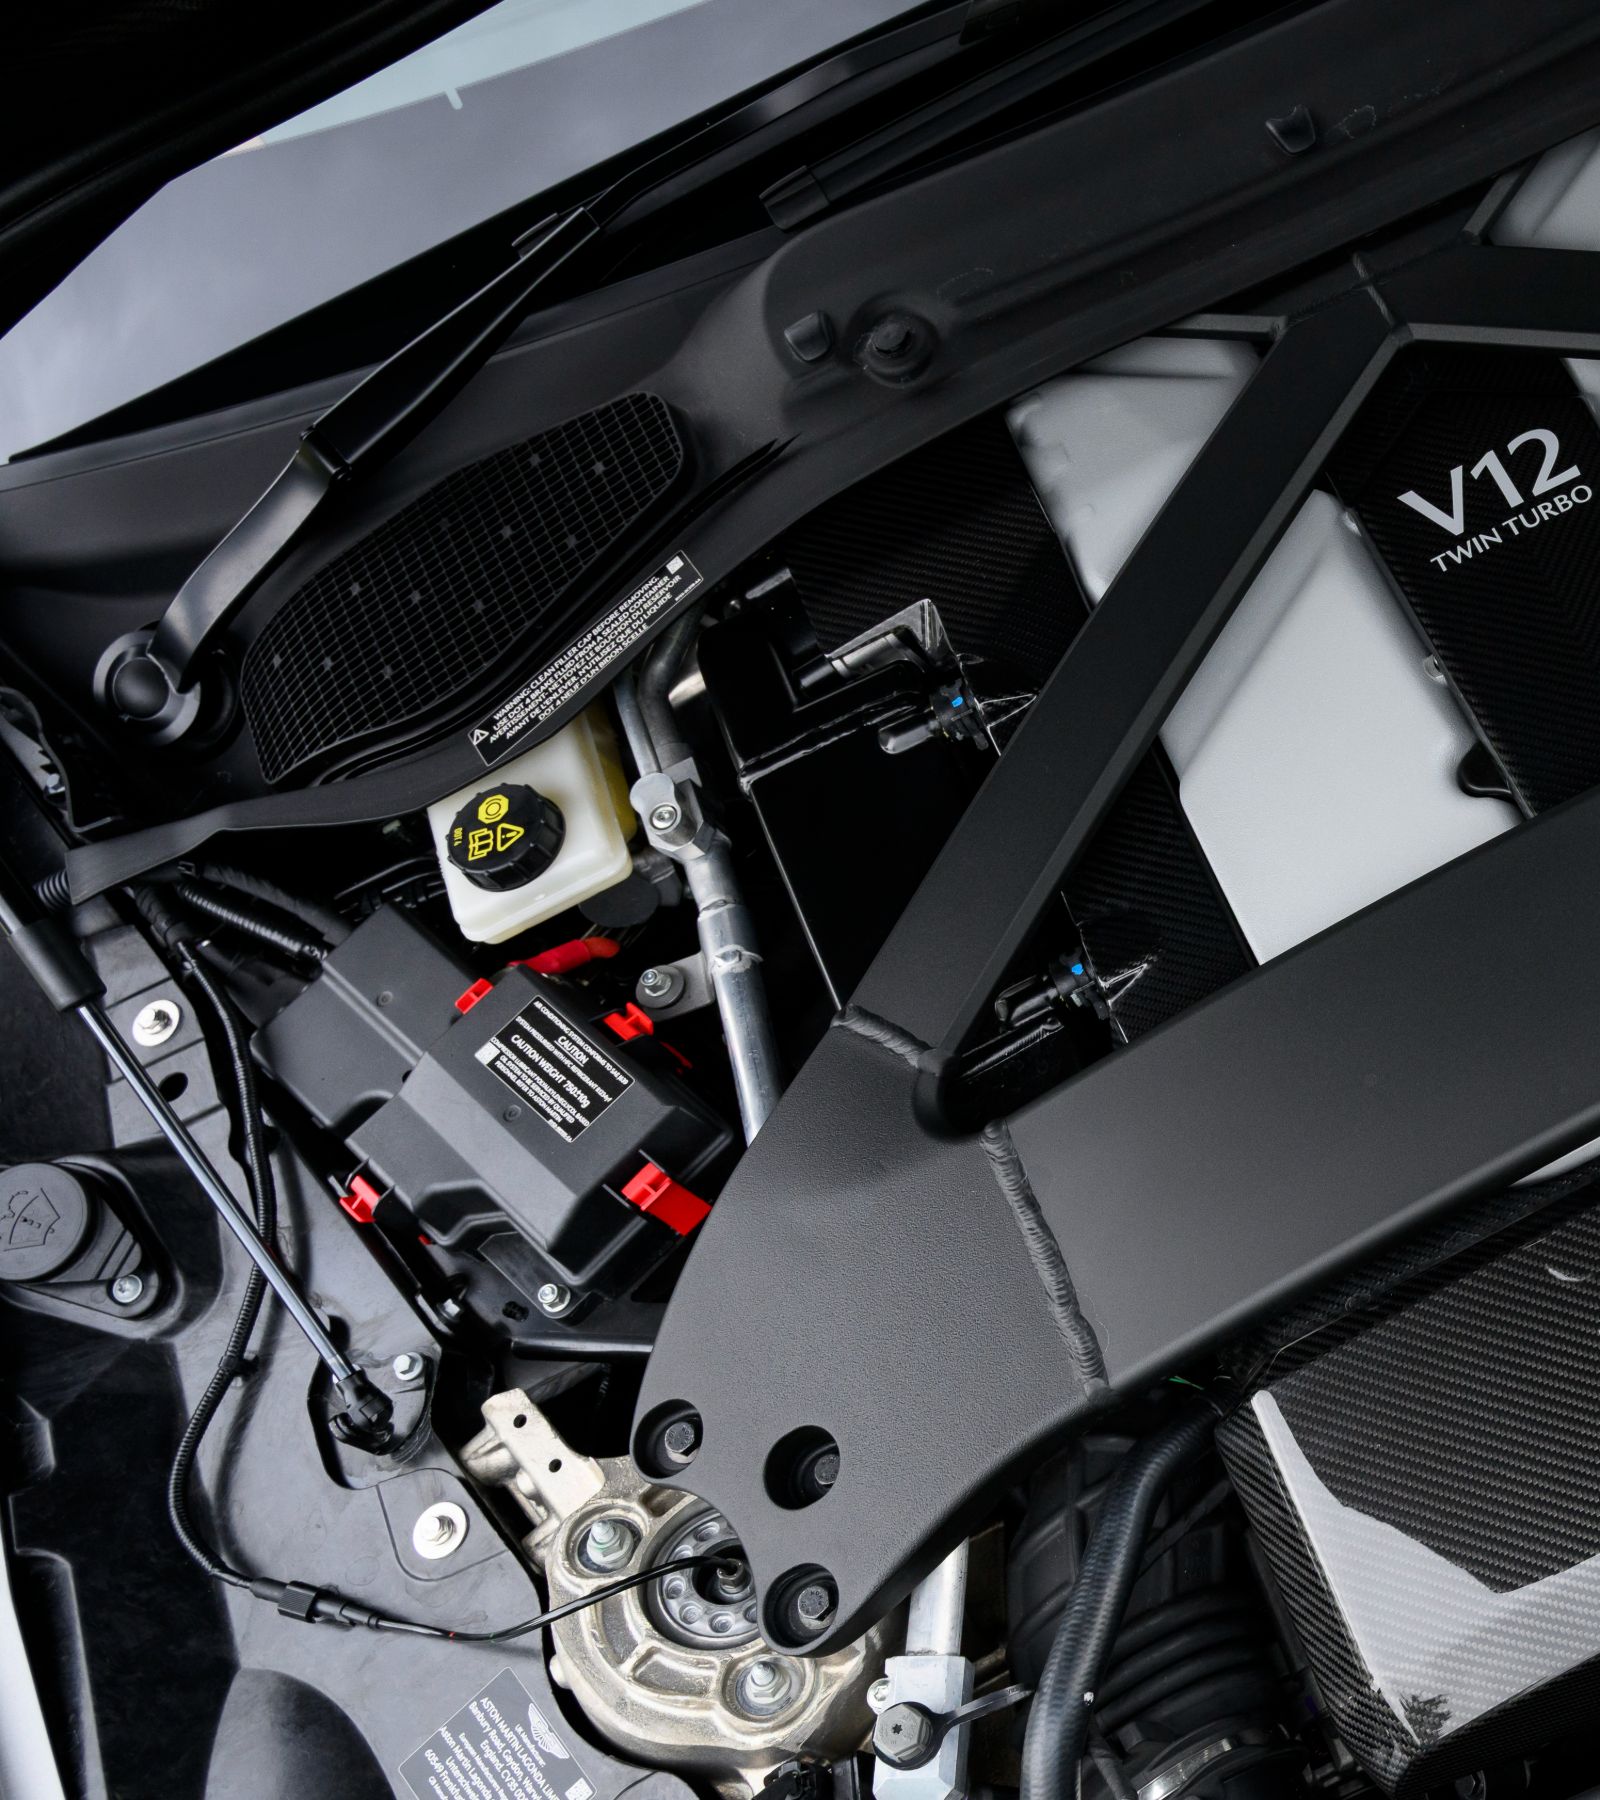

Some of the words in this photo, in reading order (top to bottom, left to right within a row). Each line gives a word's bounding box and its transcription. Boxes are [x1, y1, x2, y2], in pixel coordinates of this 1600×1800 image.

[1397, 429, 1581, 536] V12
[1430, 527, 1503, 572] TWIN
[1502, 485, 1592, 535] TURBO
[493, 716, 509, 733] USE
[508, 702, 524, 719] DOT
[530, 677, 555, 700] BRAKE
[554, 659, 575, 679] FLUID
[574, 640, 597, 661] FROM
[601, 611, 629, 637] SEALED
[629, 576, 670, 613] CONTAINER
[493, 688, 532, 720] WARNING:
[530, 666, 556, 689] CLEAN
[554, 646, 579, 669] FILLER
[577, 633, 592, 648] CAP
[592, 610, 621, 636] BEFORE
[506, 716, 530, 739] AVANT
[529, 707, 542, 718] DE
[578, 641, 617, 676] N'UTILISEZ
[616, 627, 633, 643] QUE
[631, 617, 644, 629] DU
[642, 592, 672, 619] LIQUIDE
[538, 704, 557, 722] DOT
[560, 682, 581, 702] NEUF
[580, 666, 600, 685] D'UN
[598, 645, 623, 670] BIDON
[622, 623, 650, 649] SCELLE
[547, 656, 586, 693] NETTOYEZ
[584, 648, 595, 661] LE
[594, 617, 633, 652] BOUCHON
[631, 607, 644, 620] DU
[642, 575, 682, 610] RESERVOIR
[454, 827, 463, 840] DOT
[511, 1034, 542, 1062] CAUTION
[538, 1058, 566, 1083] WEIGHT
[533, 1001, 543, 1009] AIR
[540, 1006, 571, 1034] CONDITIONING
[568, 1031, 585, 1047] SYSTEM
[582, 1044, 607, 1066] CONFORMS
[604, 1062, 613, 1071] TO
[610, 1068, 620, 1078] SAE
[557, 1036, 589, 1064] CAUTION
[424, 1749, 444, 1773] 60549
[439, 1726, 456, 1748] Aston
[452, 1745, 472, 1771] Martin
[469, 1701, 492, 1733] Banbury
[488, 1729, 506, 1753] Road,
[502, 1749, 524, 1782] Gaydon,
[480, 1697, 502, 1724] ASTON
[497, 1720, 522, 1752] MARTIN
[517, 1747, 546, 1788] LAGONDA
[501, 1769, 519, 1791] CV35
